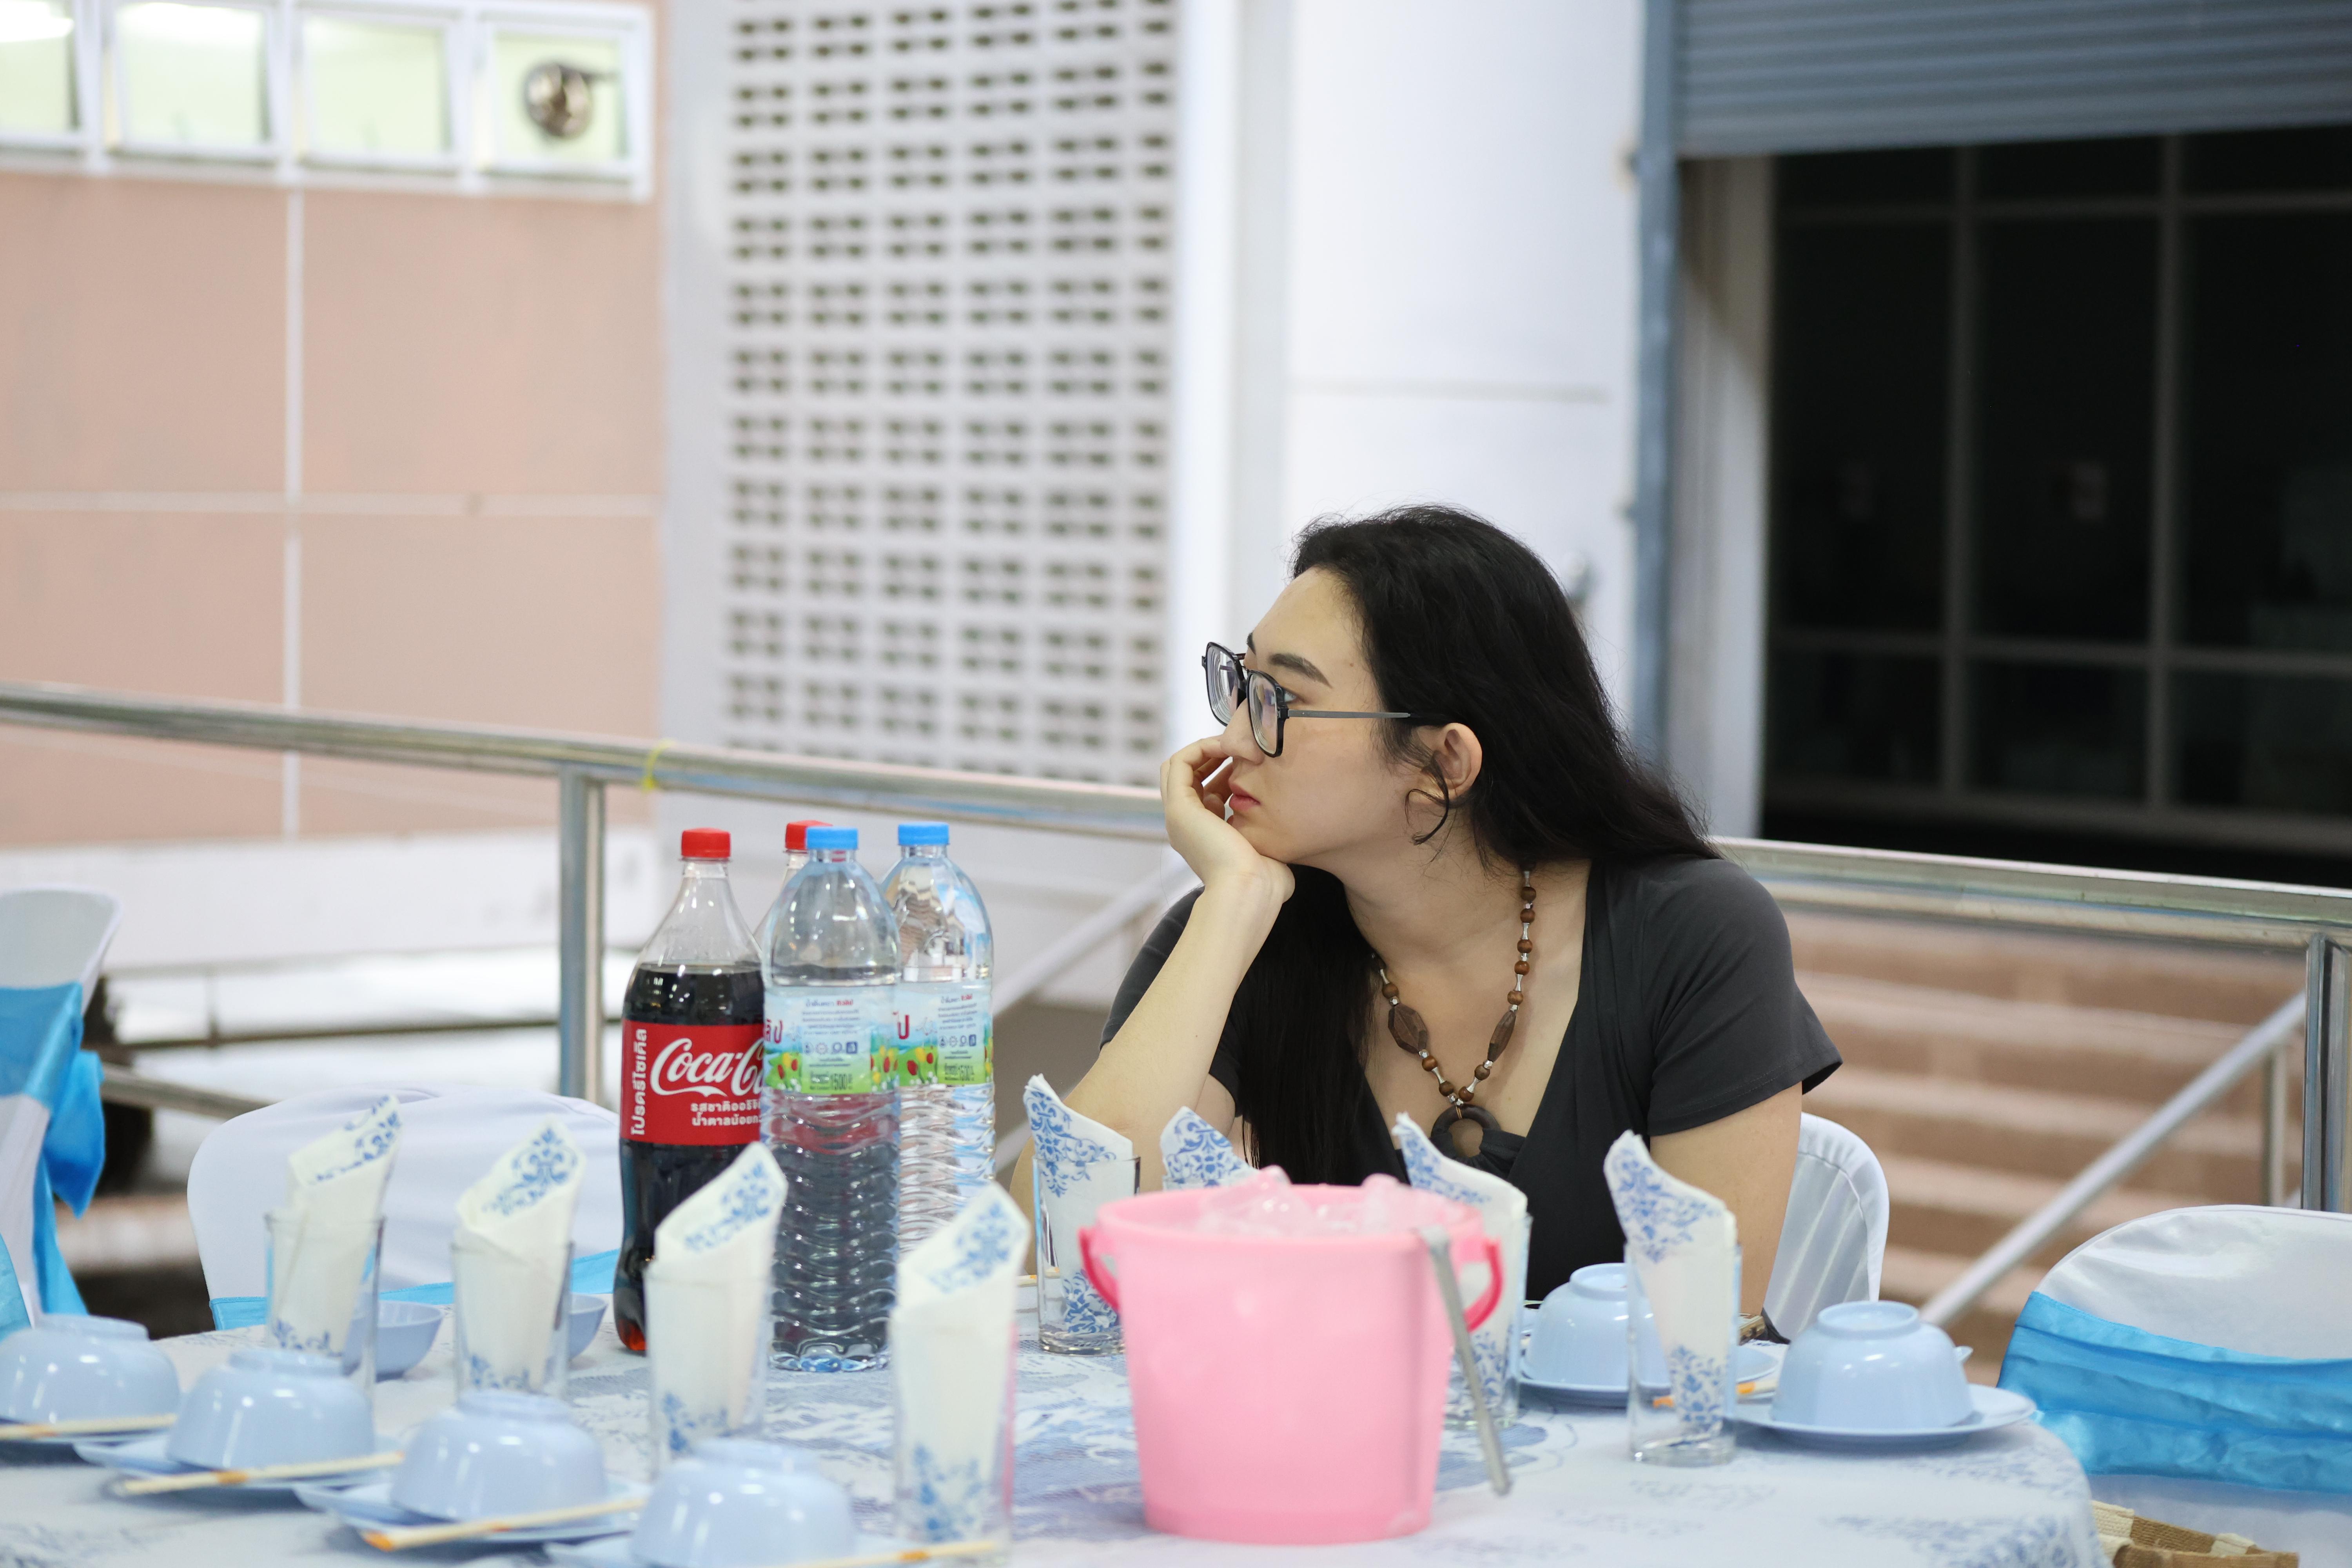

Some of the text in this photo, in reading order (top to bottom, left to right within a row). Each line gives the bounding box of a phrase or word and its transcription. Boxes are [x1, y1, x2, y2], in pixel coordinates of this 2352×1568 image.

[630, 1029, 647, 1135] โปรดรีไซเคิล
[650, 1037, 764, 1097] Coca-Co
[691, 1099, 760, 1112] รสชาติออริจิ
[692, 1112, 762, 1126] น้ำตาลน้อยก
